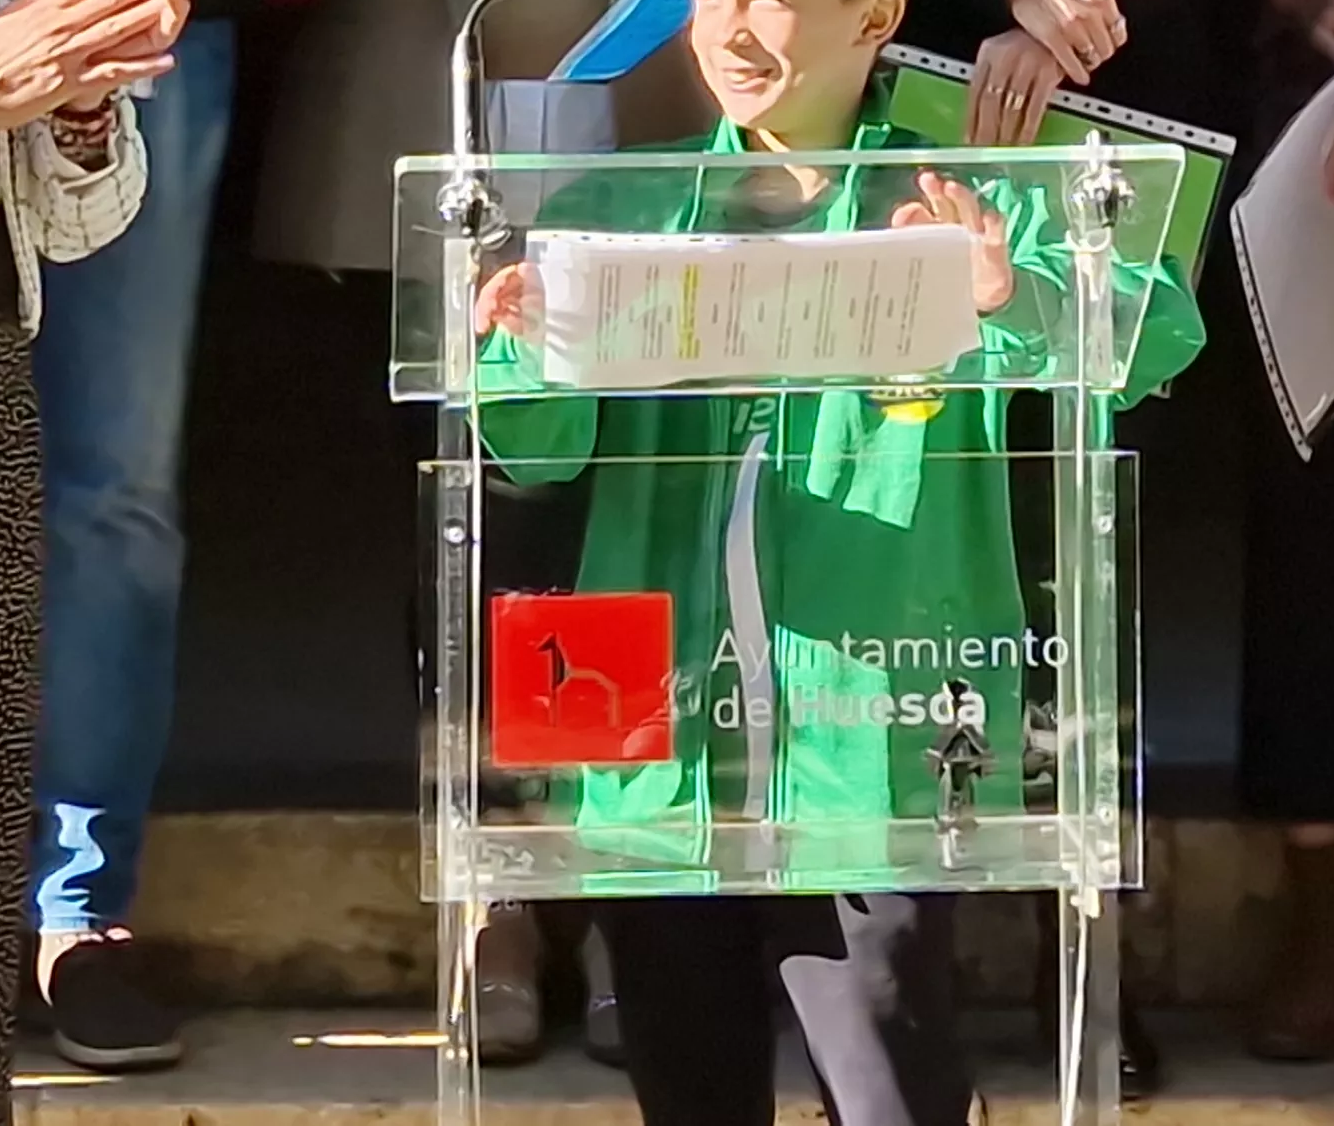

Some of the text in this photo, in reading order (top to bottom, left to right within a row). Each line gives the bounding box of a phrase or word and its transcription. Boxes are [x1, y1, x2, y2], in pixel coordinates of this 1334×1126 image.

[711, 624, 1070, 684] Ayuntamiento
[713, 682, 988, 729] de Huesca
